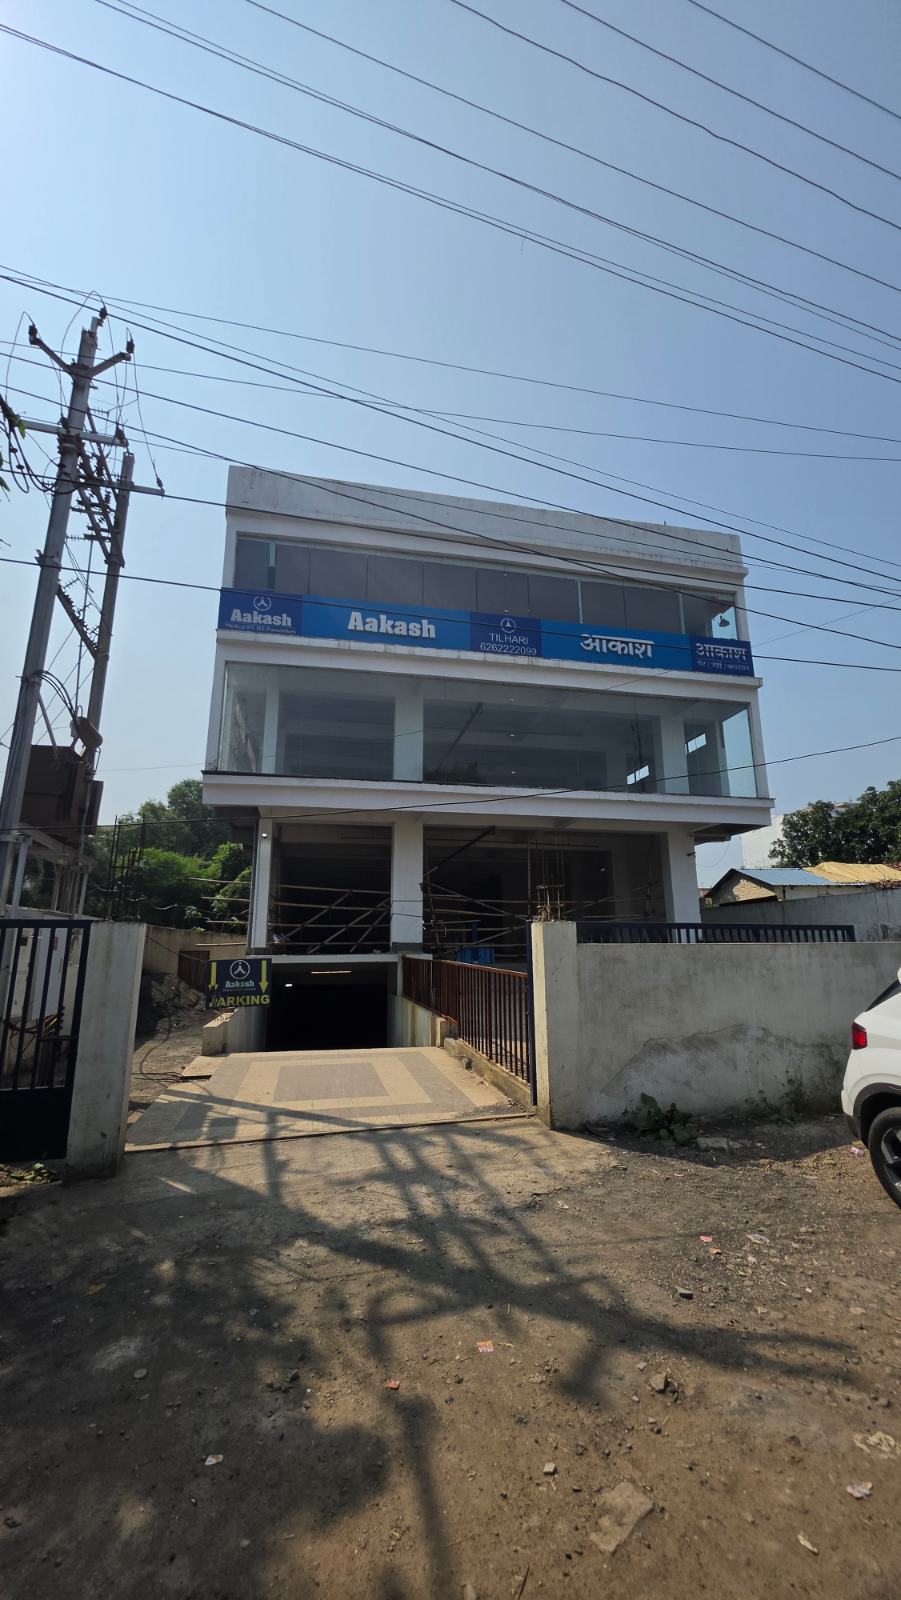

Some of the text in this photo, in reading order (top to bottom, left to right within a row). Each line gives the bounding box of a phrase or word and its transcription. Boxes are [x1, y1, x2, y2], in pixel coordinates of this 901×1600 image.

[230, 608, 292, 627] Aakash
[347, 611, 436, 639] Aakash
[490, 633, 528, 645] TILHARI
[580, 634, 655, 659] आकाश
[480, 642, 537, 656] 6262222099
[225, 980, 255, 988] Aakash
